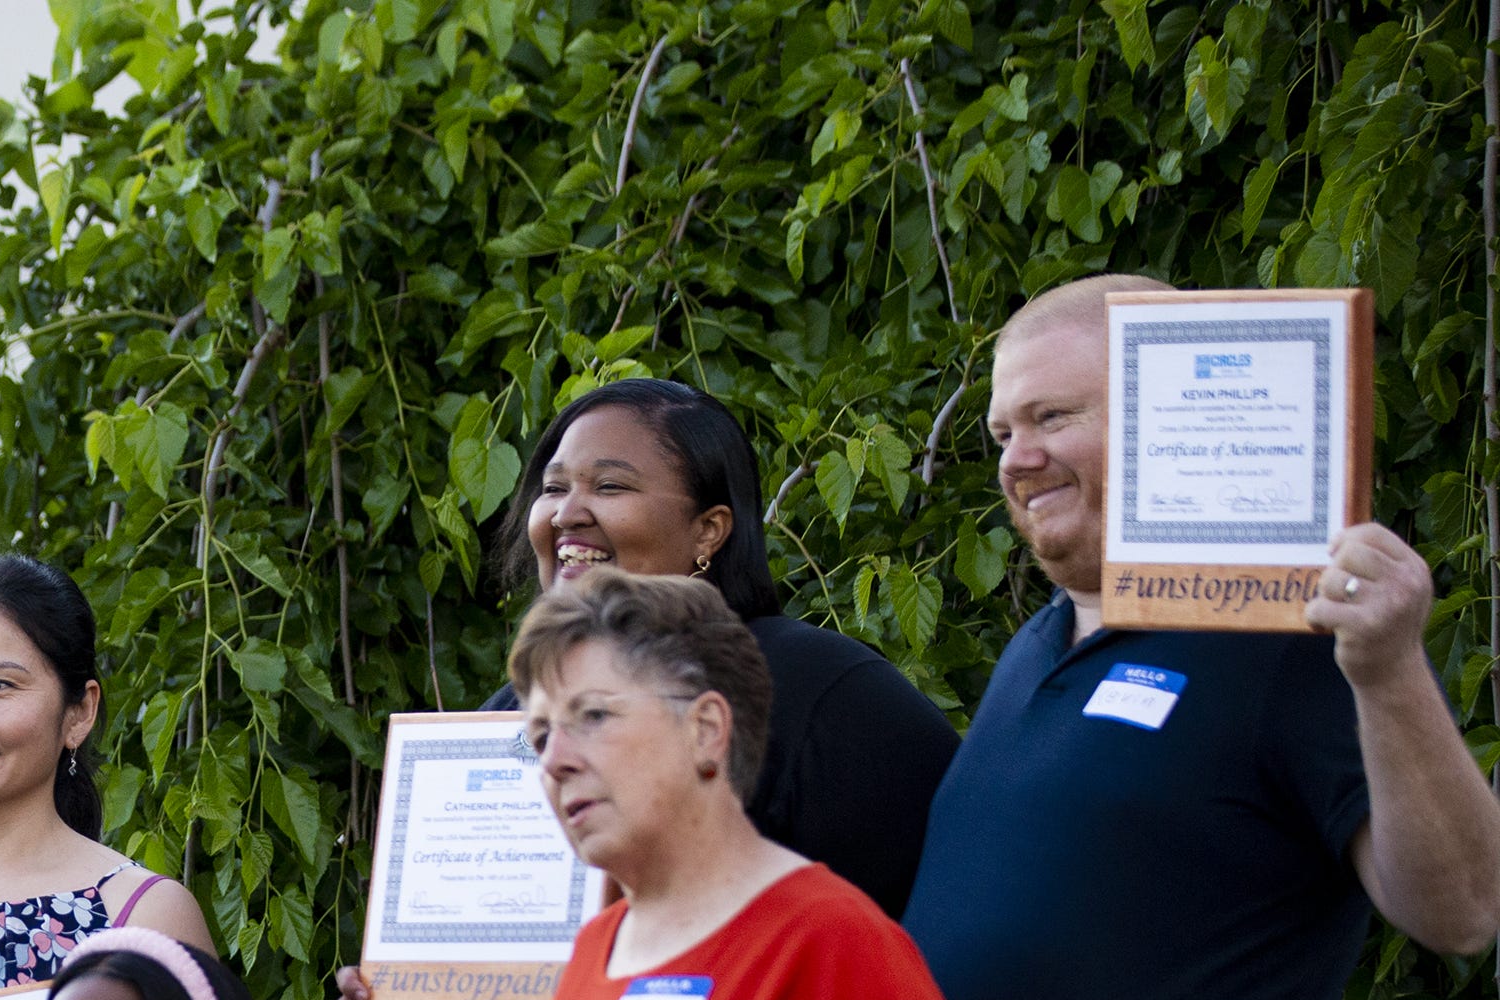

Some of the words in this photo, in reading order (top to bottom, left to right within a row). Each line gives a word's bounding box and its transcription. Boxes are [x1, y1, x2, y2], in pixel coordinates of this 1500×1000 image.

[1211, 354, 1253, 367] CIRCLES
[1181, 389, 1216, 400] KEVIN
[1218, 388, 1269, 400] PHILLIPS
[1147, 441, 1208, 461] Certificate
[1211, 441, 1225, 461] of
[1225, 441, 1305, 457] Achievement
[1114, 567, 1320, 613] #unstoppabl
[483, 769, 522, 781] CIRCLES
[501, 801, 542, 810] PHILLIPS
[412, 849, 471, 867] Certificate
[474, 848, 489, 867] of
[489, 848, 565, 863] Achievement
